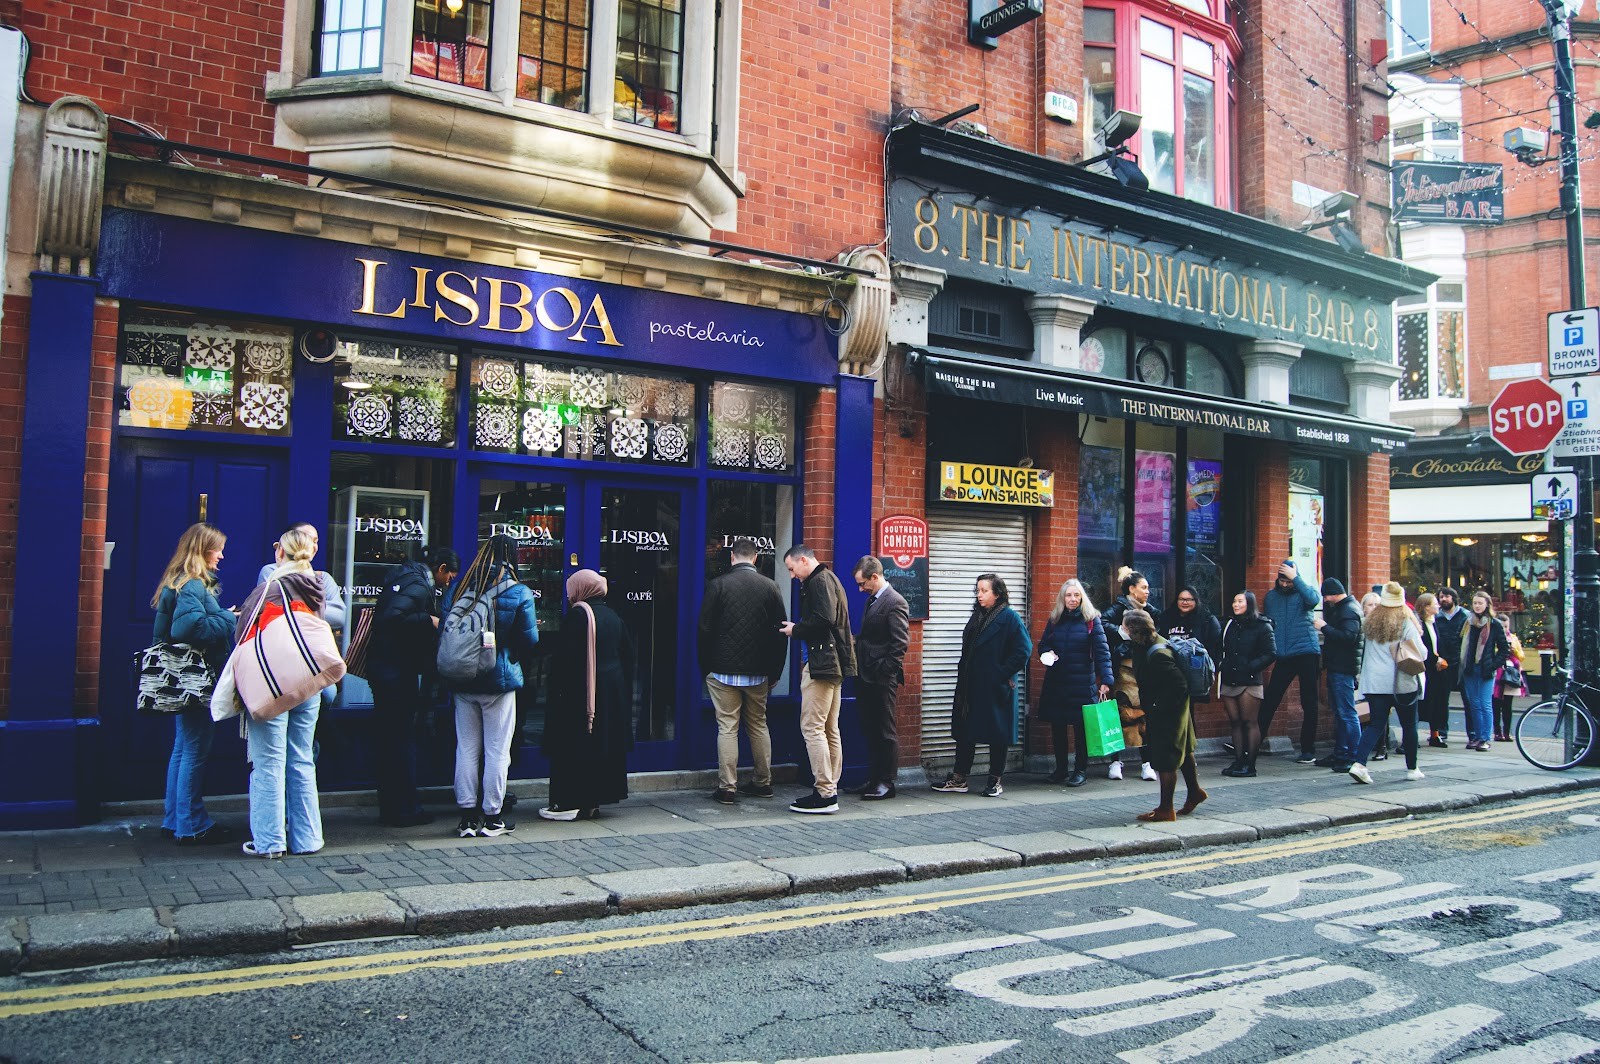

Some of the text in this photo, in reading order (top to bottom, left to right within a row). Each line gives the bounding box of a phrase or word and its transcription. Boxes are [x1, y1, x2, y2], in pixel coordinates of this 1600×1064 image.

[981, 0, 1027, 29] GUINNESS
[1446, 200, 1492, 219] BAR
[953, 203, 1031, 274] THE
[1050, 225, 1298, 332] INTERNATIONAL
[352, 257, 624, 347] LISBOA
[649, 321, 765, 348] pastelaria
[1554, 348, 1594, 360] BROWN
[1552, 359, 1598, 371] THOMAS
[935, 371, 996, 389] RAISING THE BAR
[1036, 388, 1084, 406] Live Music
[1120, 398, 1271, 433] THE INTERNATIONAL BAR
[1494, 400, 1560, 433] STOP
[1296, 426, 1350, 443] Established 1838
[1411, 457, 1503, 478] Chocolate
[1516, 453, 1545, 474] Caf
[960, 465, 1038, 490] LOUNGE
[1190, 470, 1215, 484] COMEDY
[355, 517, 427, 534] LISBOA
[490, 523, 554, 541] LISBOA
[884, 525, 923, 534] SOUTHERN
[386, 533, 424, 542] pastelaria
[611, 530, 669, 546] LISBOA
[723, 534, 775, 550] LIBOA
[883, 534, 925, 548] COMFORT
[635, 544, 669, 552] pastelaria
[626, 590, 652, 601] CAFÉ
